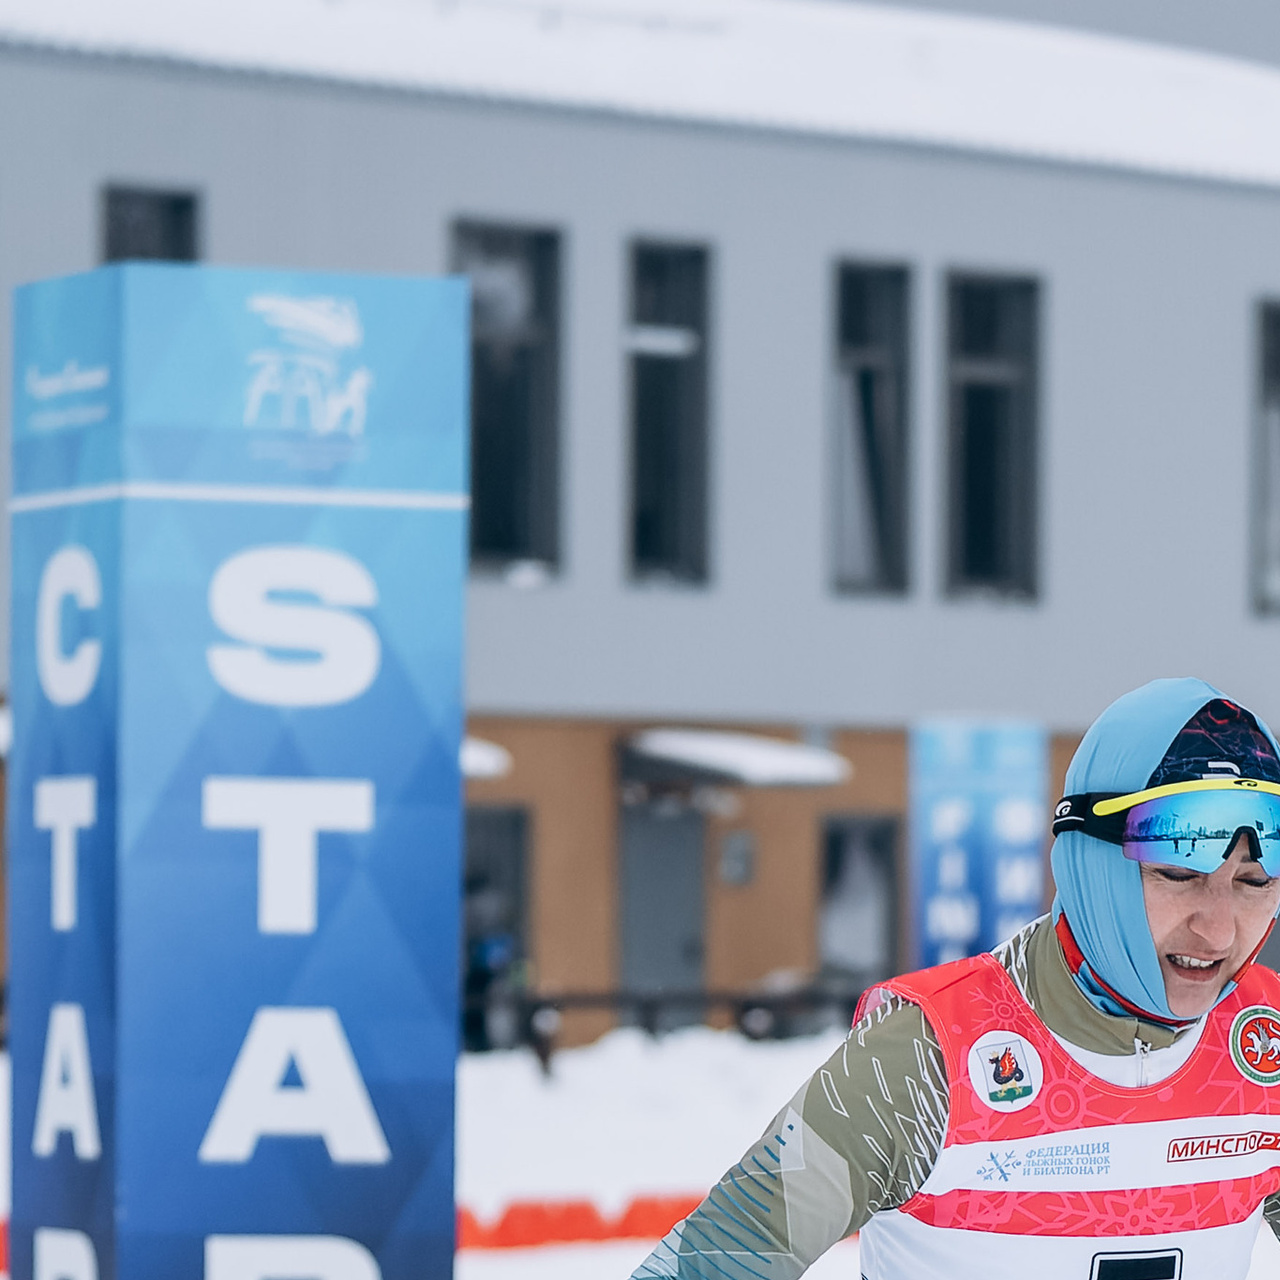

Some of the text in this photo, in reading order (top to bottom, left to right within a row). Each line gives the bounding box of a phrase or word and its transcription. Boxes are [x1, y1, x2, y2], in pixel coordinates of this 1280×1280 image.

[1025, 1141, 1110, 1159] ФЕДЕРАЦИЯ
[1023, 1156, 1110, 1167] ЛЫЖНЫХ ГОНОК
[1022, 1165, 1110, 1176] И БИАТЛОНА РТ
